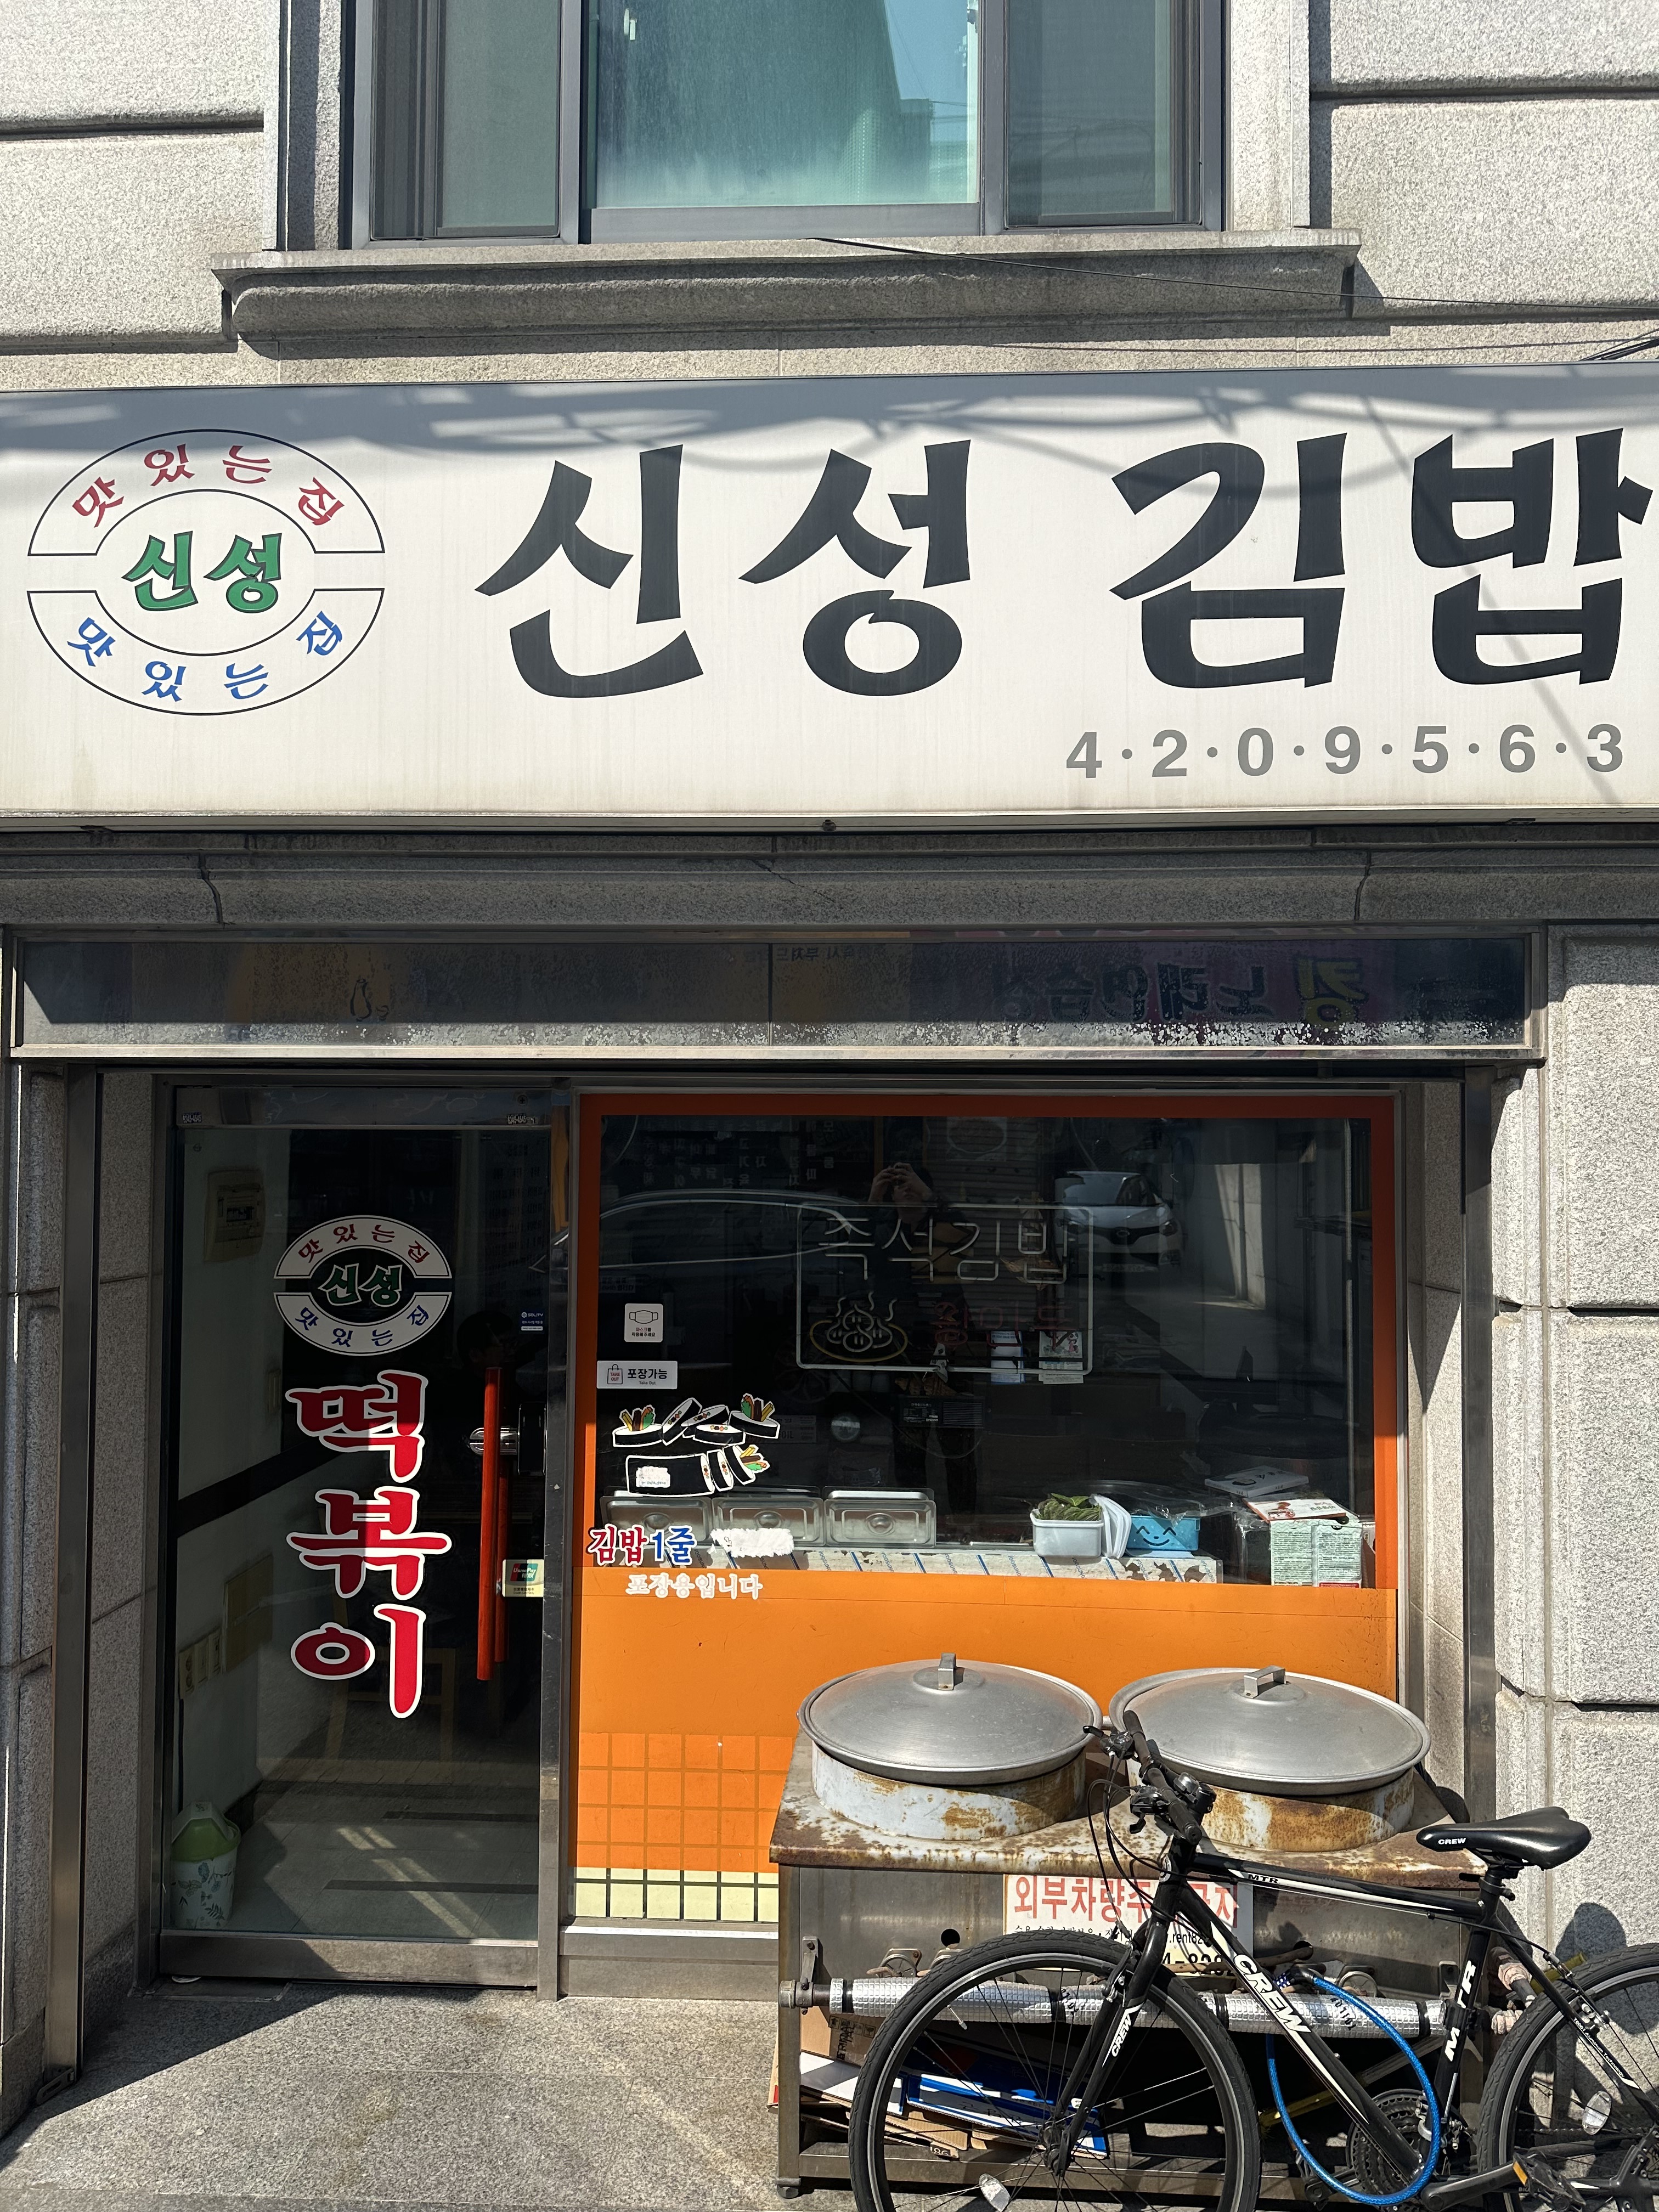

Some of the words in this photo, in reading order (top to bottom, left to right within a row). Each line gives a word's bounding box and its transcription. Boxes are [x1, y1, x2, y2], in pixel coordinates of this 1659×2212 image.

[122, 531, 282, 613] 신성
[476, 441, 974, 697] 신성
[1109, 428, 1653, 688] 김밥
[320, 1263, 403, 1307] 신성
[628, 1368, 668, 1379] 포장가능
[625, 1572, 763, 1600] 포장용입니다
[1438, 1837, 1466, 1846] CREW
[1248, 1874, 1279, 1885] MTR
[1232, 1952, 1312, 2034] CREW
[1111, 2014, 1132, 2057] CREW
[1584, 2032, 1604, 2054] Aluminum
[1604, 2052, 1625, 2078] Technology
